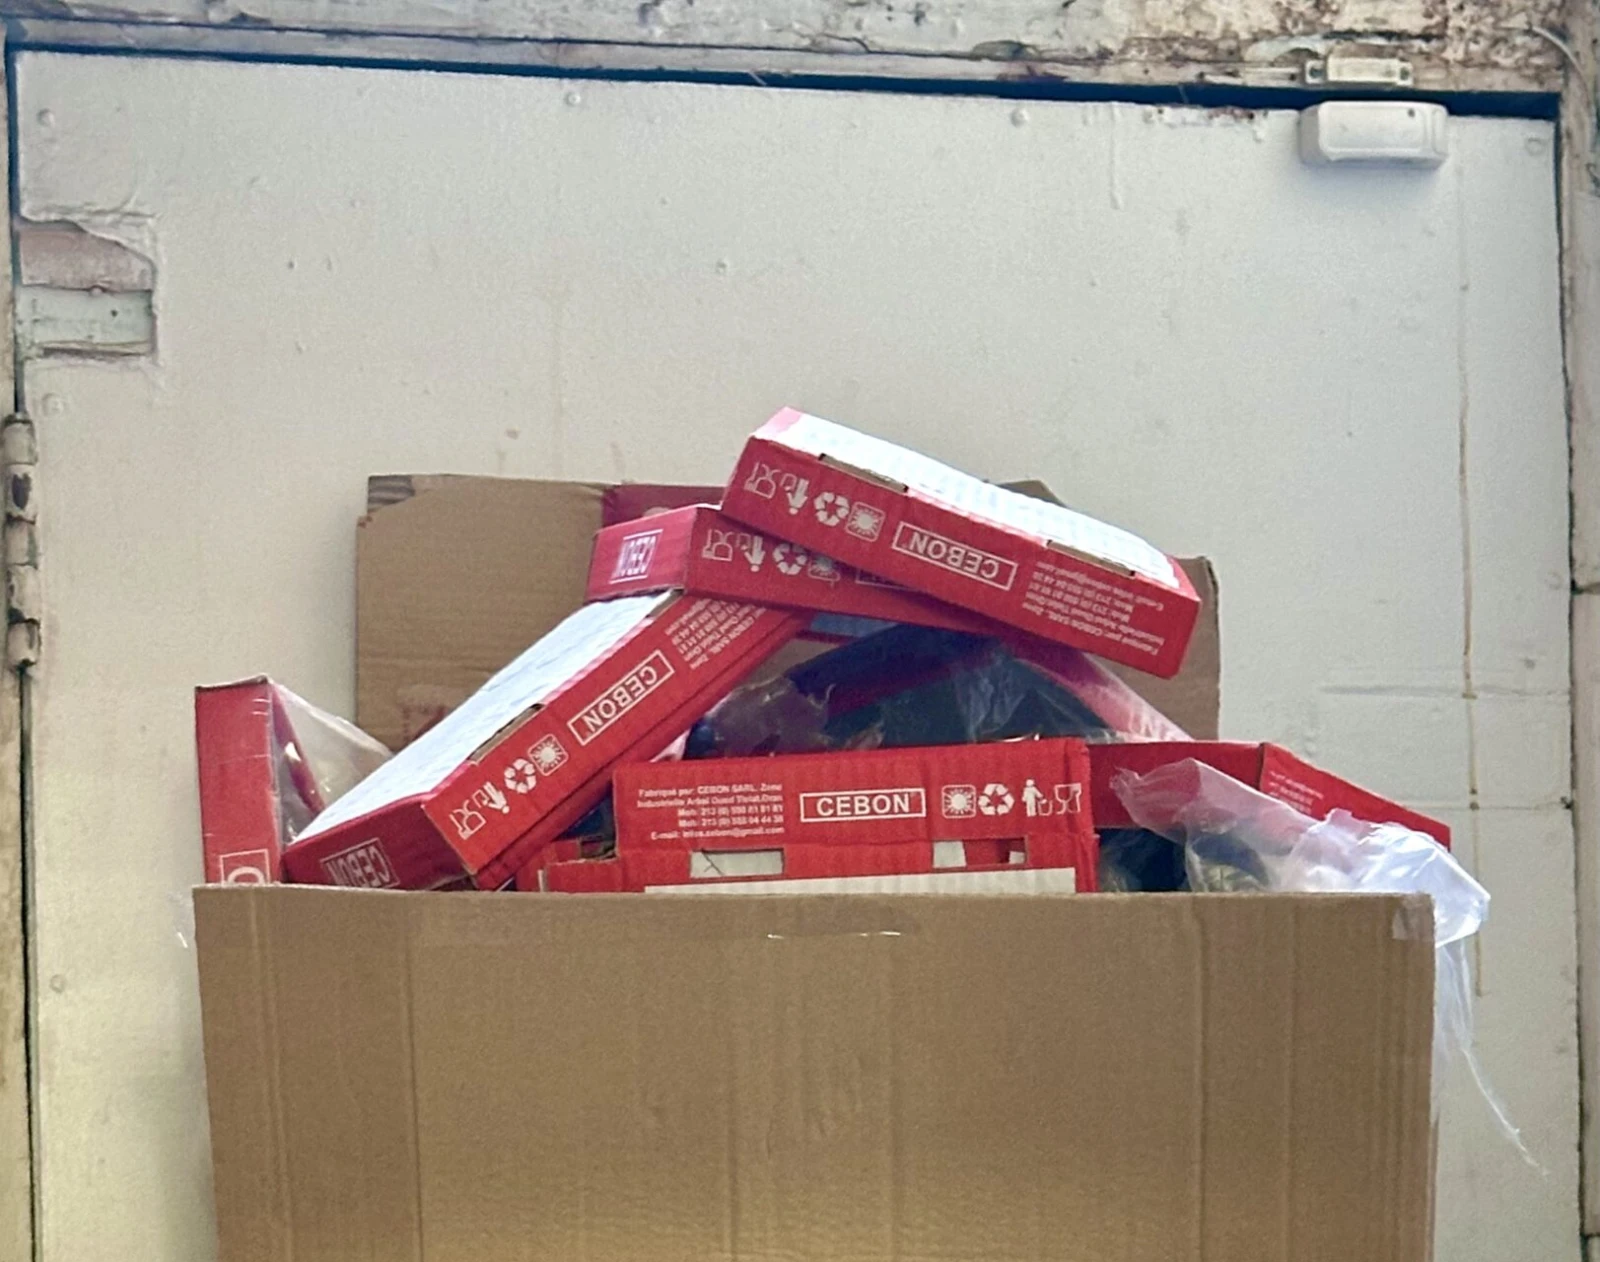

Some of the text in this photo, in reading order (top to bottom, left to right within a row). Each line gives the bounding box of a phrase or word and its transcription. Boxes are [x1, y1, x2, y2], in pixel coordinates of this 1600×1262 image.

[908, 531, 1000, 579] CEBON
[581, 666, 658, 732] CEBON
[697, 784, 730, 795] CEBON
[816, 793, 910, 816] CEBON
